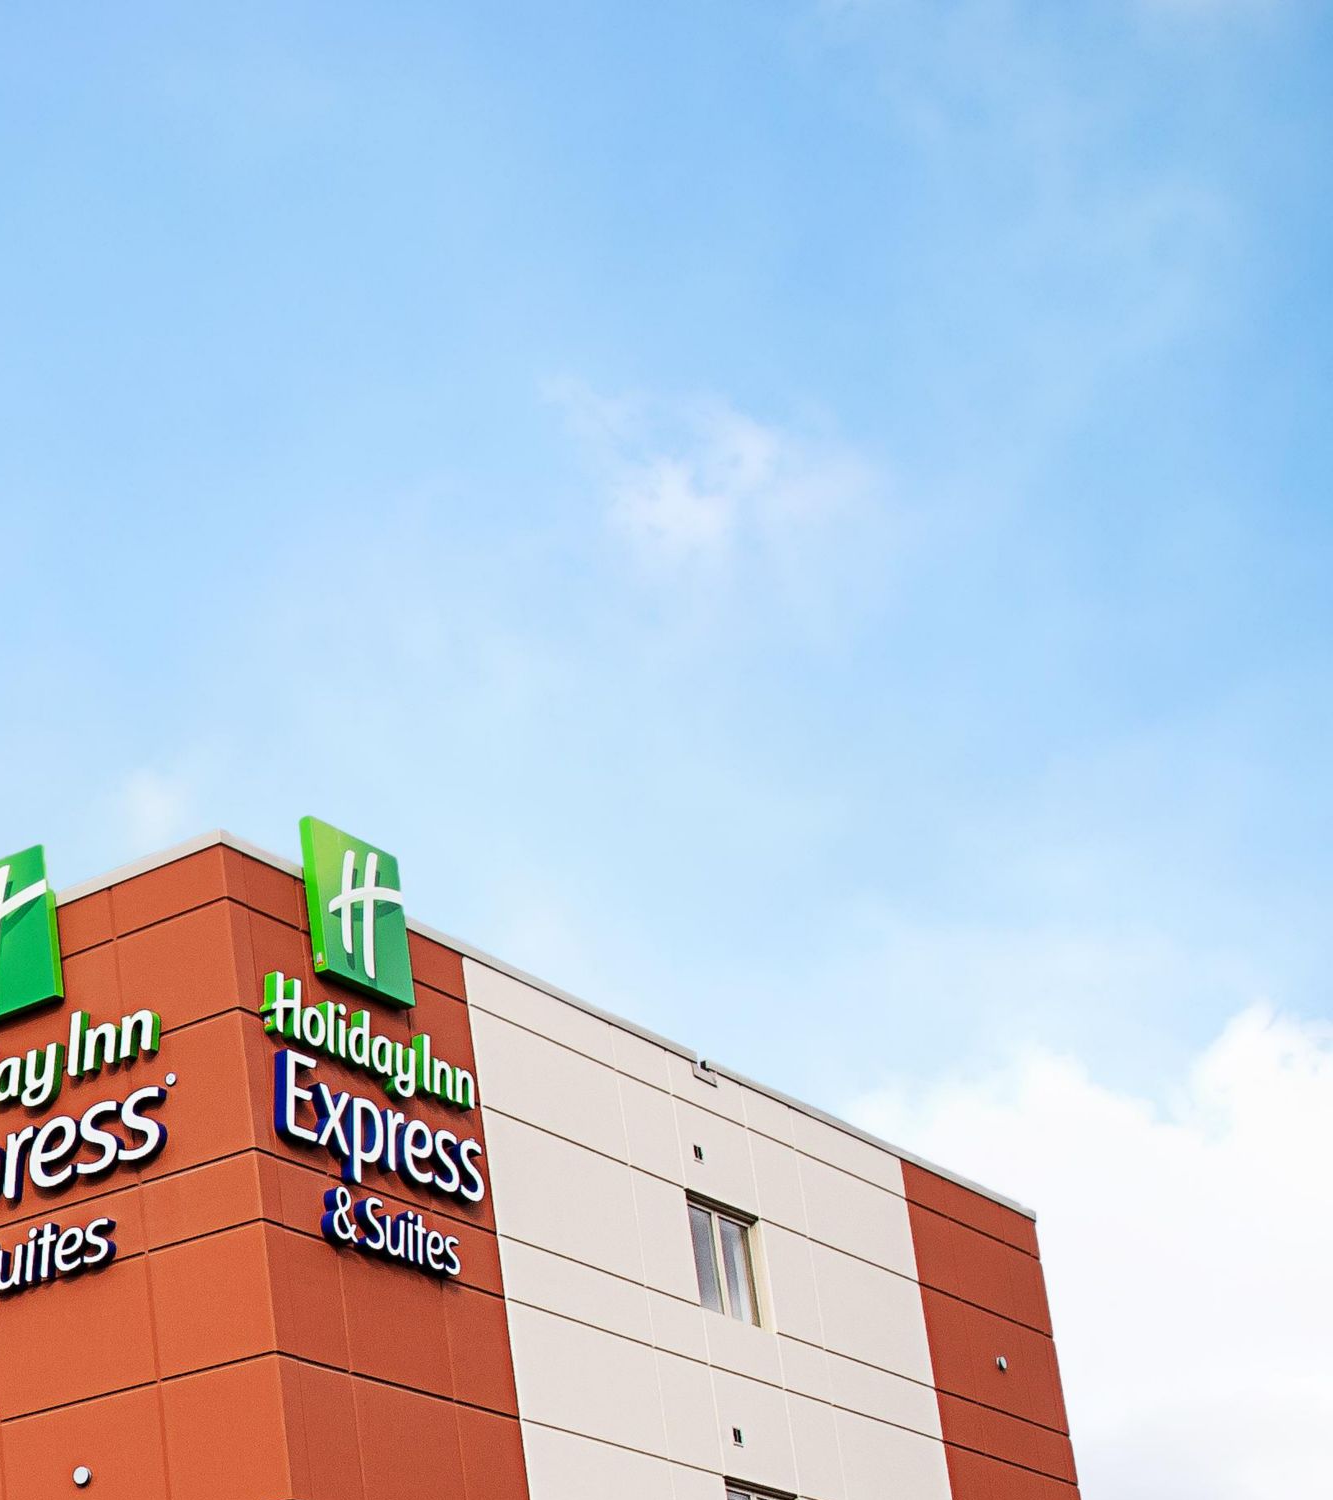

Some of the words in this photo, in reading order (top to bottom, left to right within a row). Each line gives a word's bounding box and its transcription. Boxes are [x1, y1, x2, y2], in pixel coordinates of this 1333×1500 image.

[67, 1009, 159, 1077] Inn
[263, 970, 416, 1098] Holiday
[414, 1033, 475, 1109] Inn
[280, 1049, 484, 1202] Express
[326, 1186, 357, 1243] &
[360, 1197, 461, 1276] Suites
